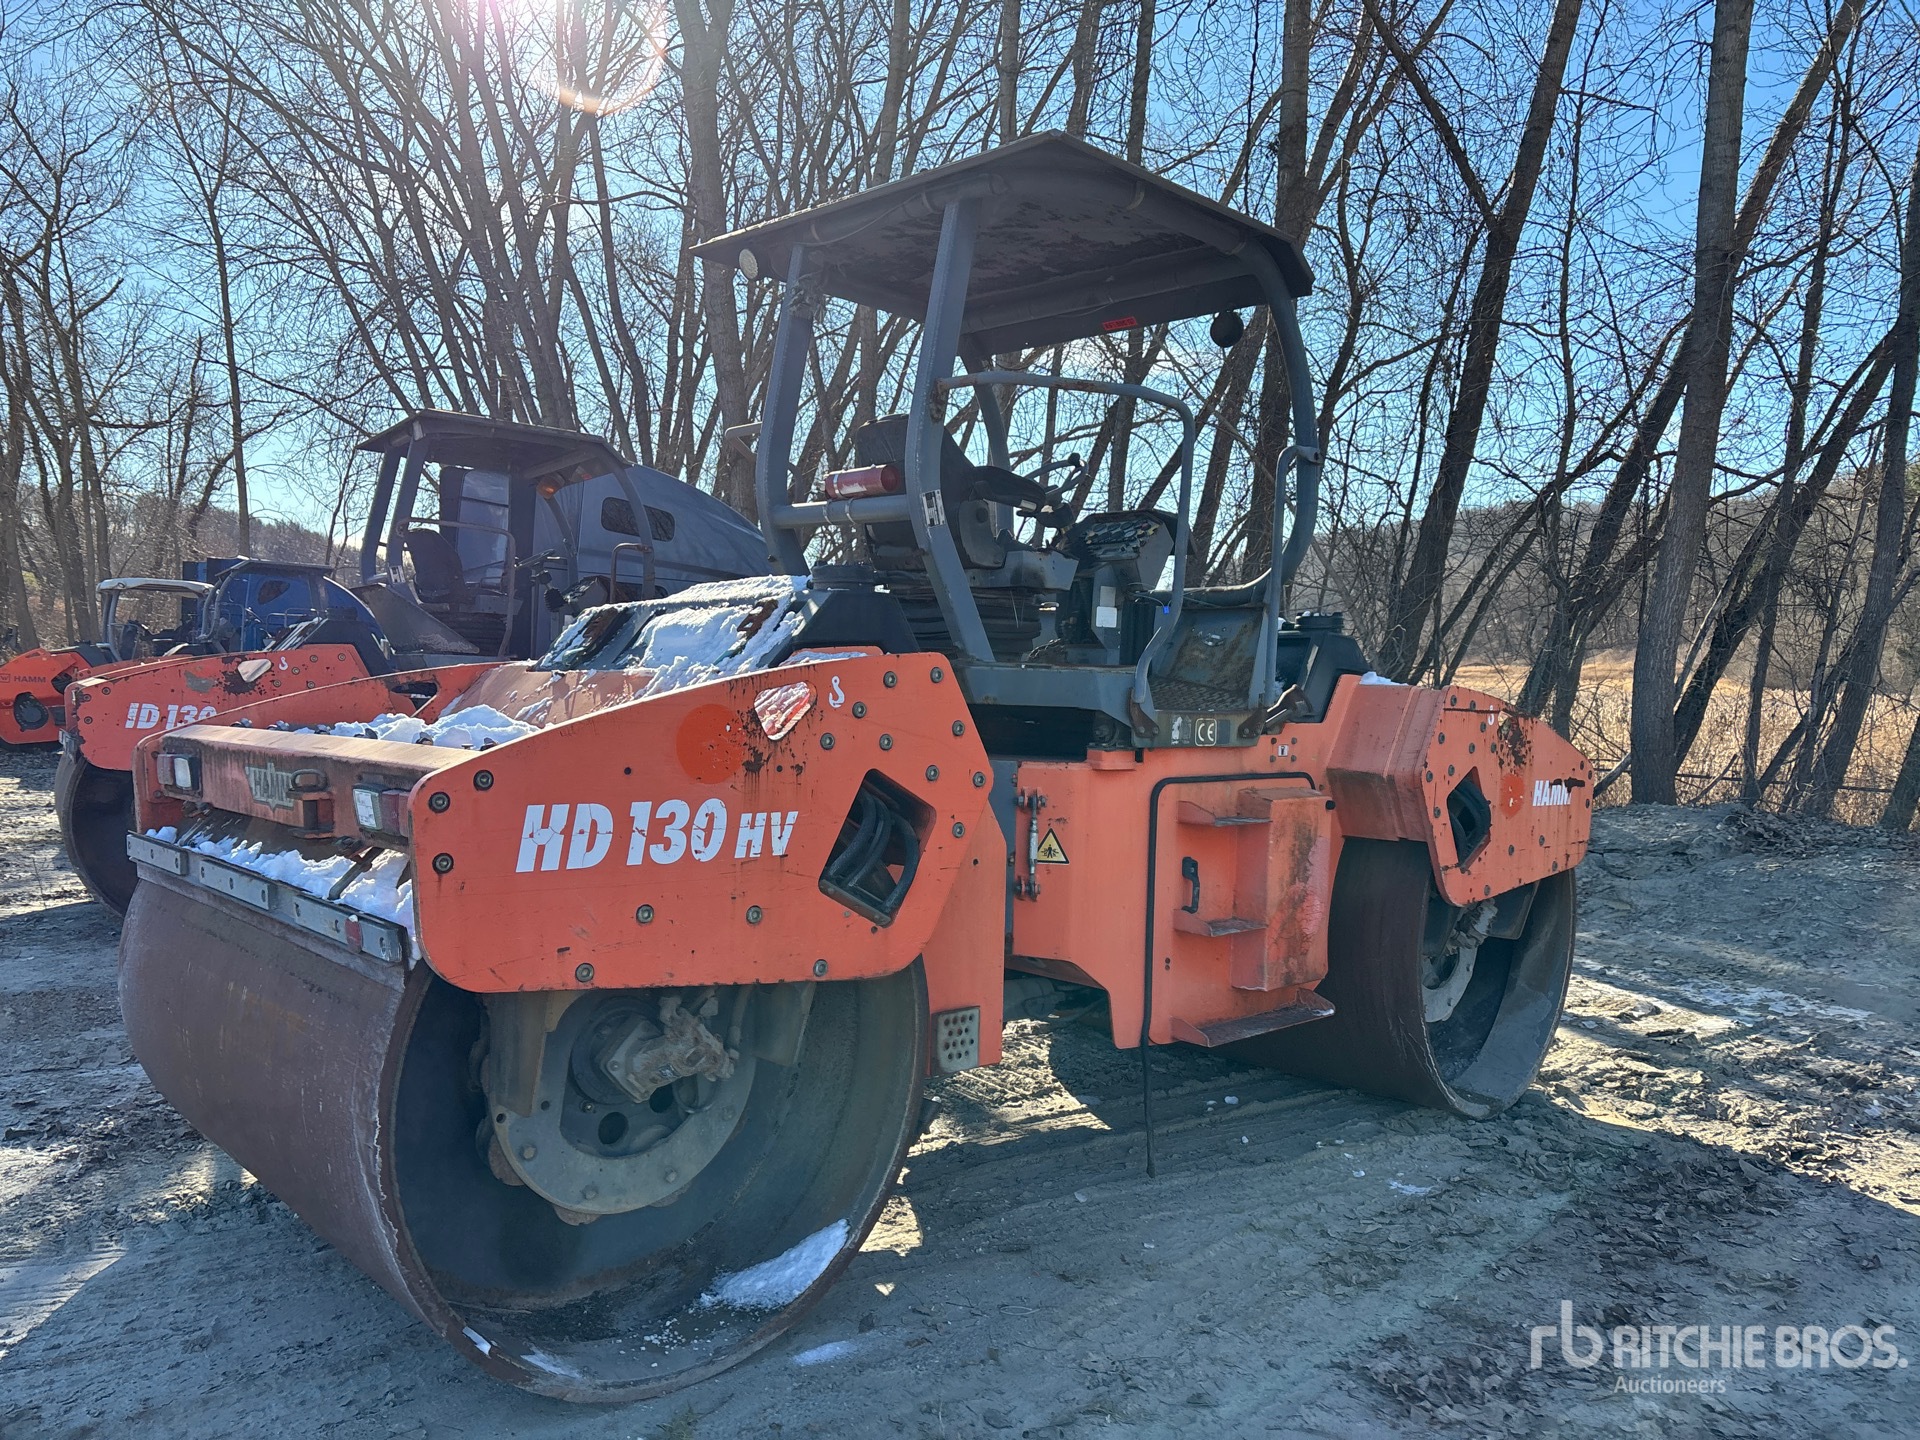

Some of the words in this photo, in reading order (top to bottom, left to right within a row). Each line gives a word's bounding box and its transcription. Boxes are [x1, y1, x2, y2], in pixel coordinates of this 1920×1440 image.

[13, 675, 46, 683] HAMM
[1197, 722, 1215, 742] CE
[515, 802, 614, 873] HD
[626, 797, 728, 867] 130
[734, 810, 799, 860] HV
